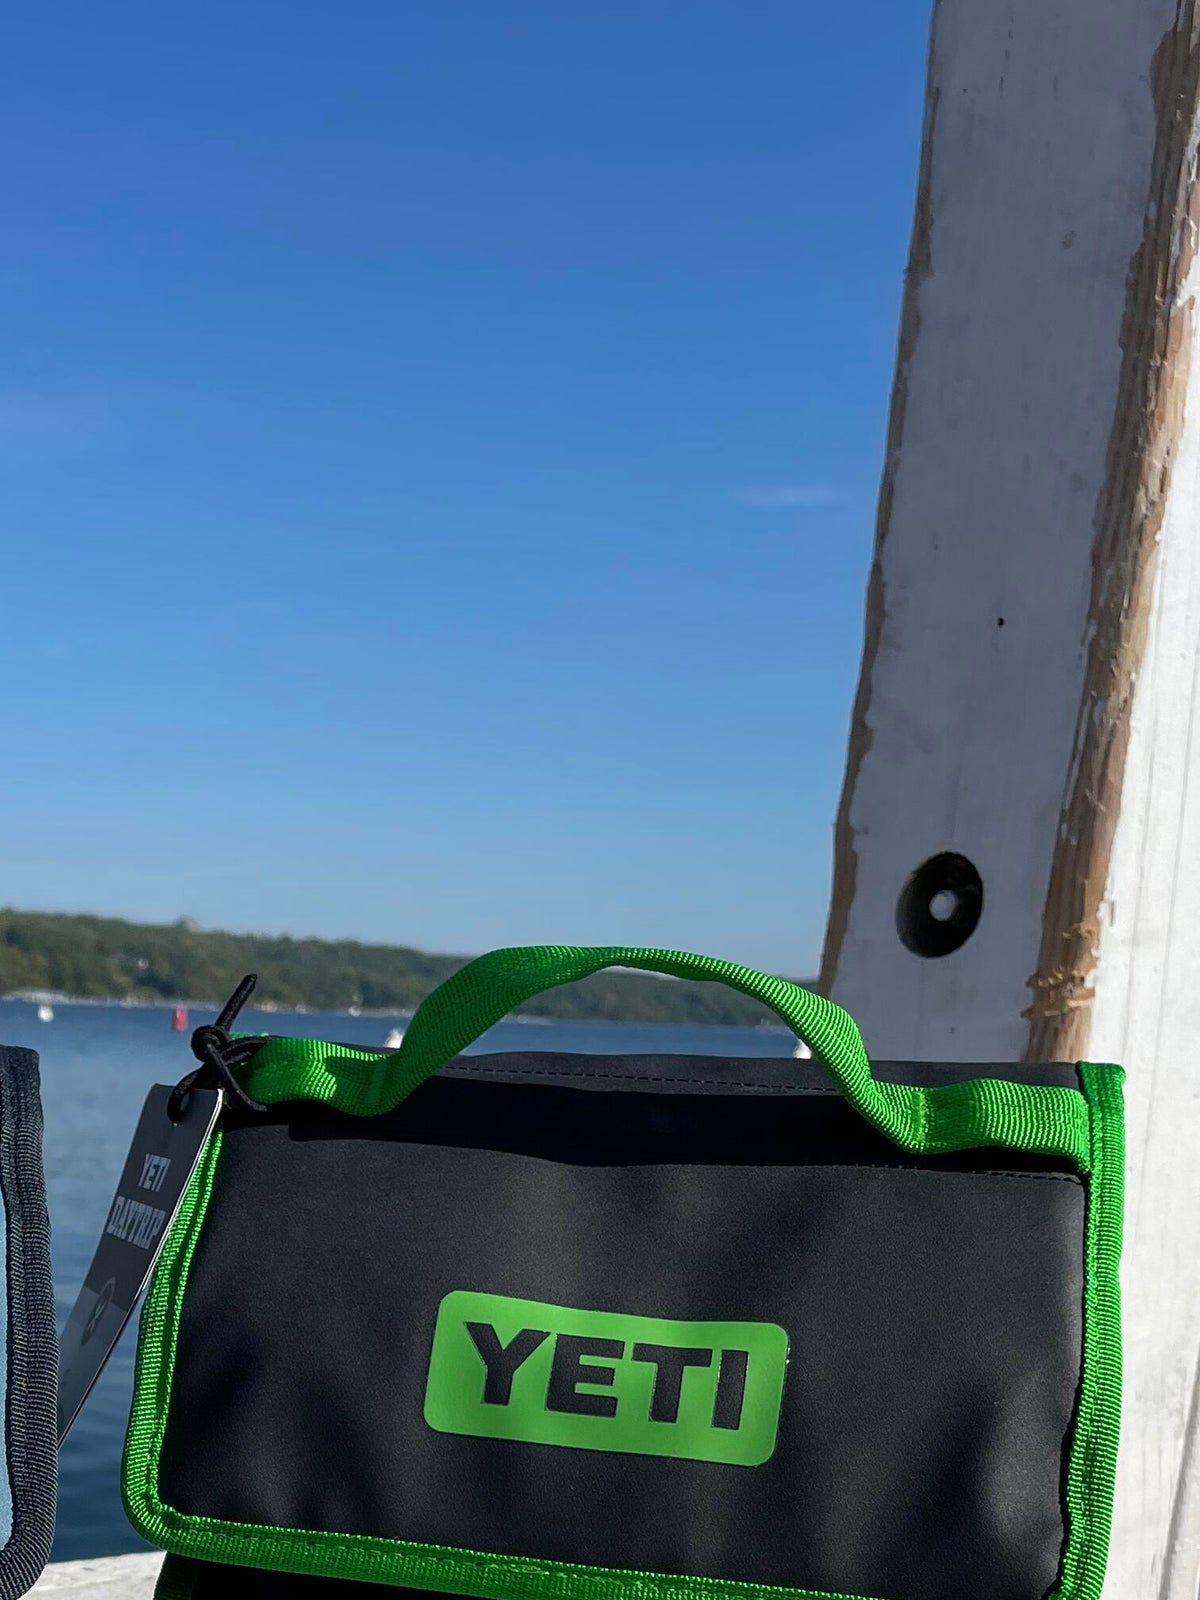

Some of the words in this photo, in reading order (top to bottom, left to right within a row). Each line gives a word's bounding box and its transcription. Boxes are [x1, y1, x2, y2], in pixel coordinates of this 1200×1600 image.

[138, 1153, 171, 1192] YETI
[107, 1197, 166, 1250] DAYTRIP
[463, 1321, 749, 1431] YETI
